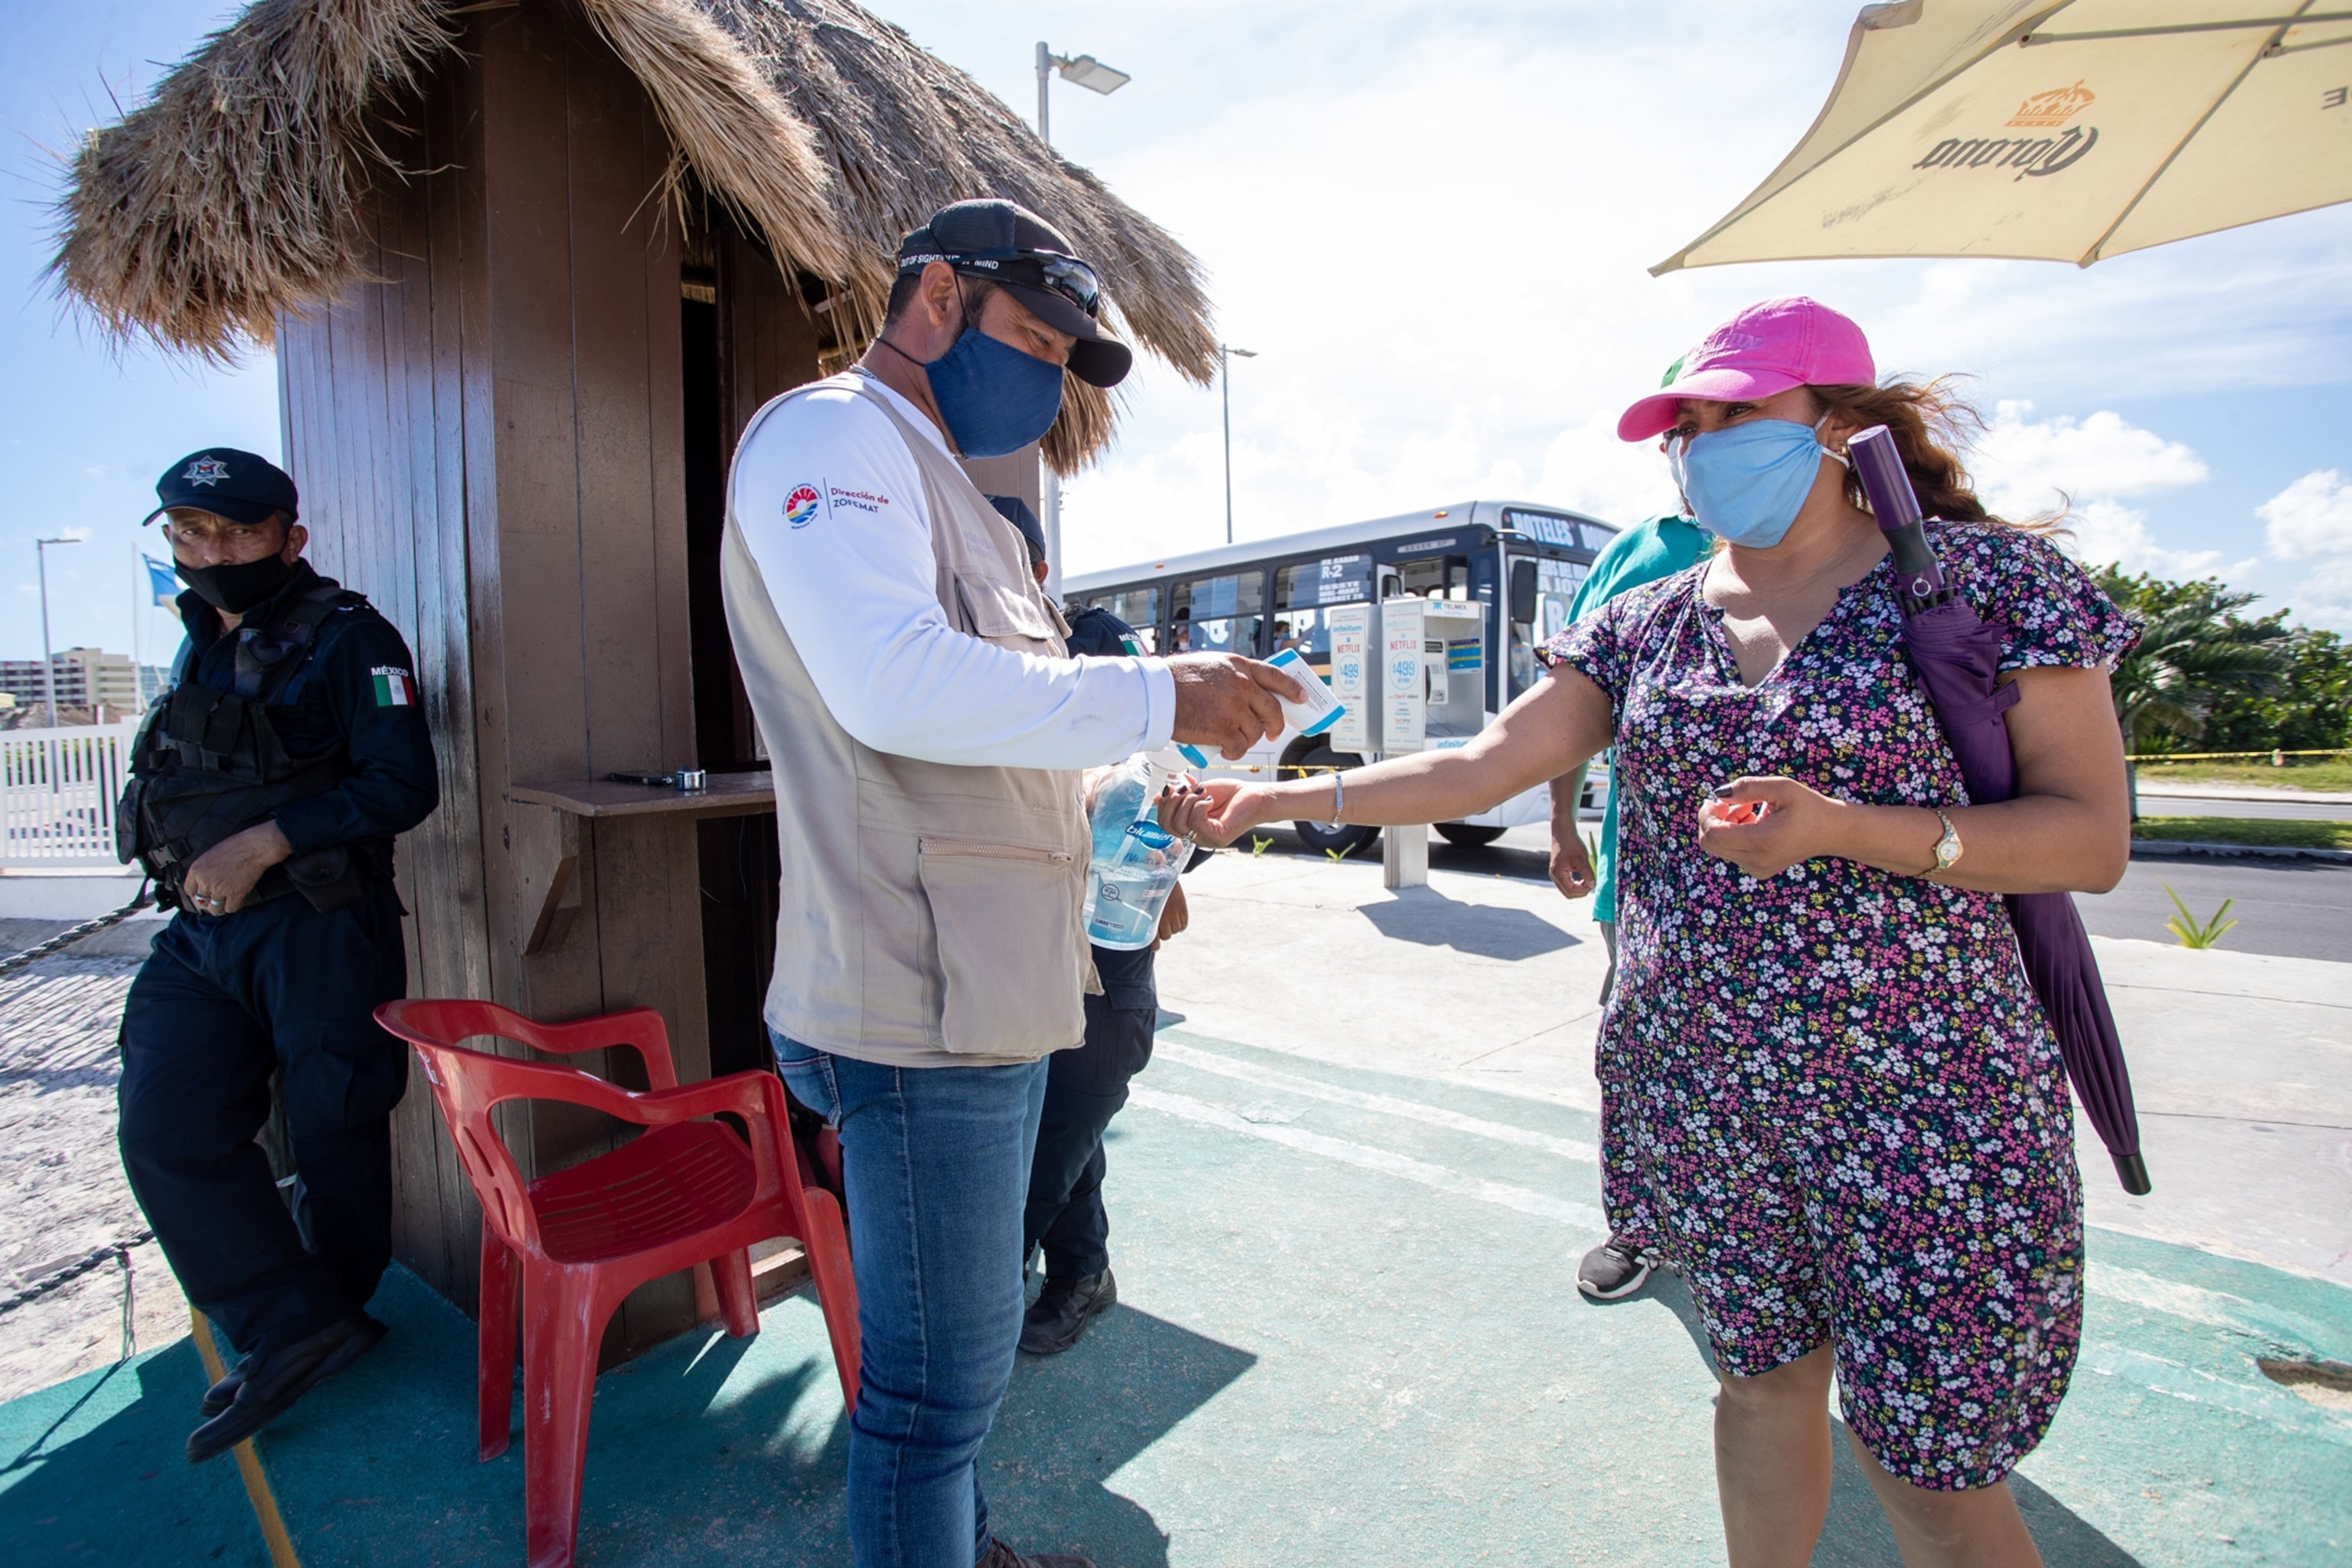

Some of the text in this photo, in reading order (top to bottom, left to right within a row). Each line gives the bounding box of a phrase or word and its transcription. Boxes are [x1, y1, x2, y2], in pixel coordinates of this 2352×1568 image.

[974, 260, 999, 270] MIND
[831, 487, 890, 505] Dirección de
[1510, 511, 1575, 547] HOTELES
[1321, 564, 1343, 579] R-2
[1333, 625, 1363, 633] infinitum
[1337, 644, 1360, 654] NETFLIX
[1390, 640, 1416, 650] NETFLIX
[371, 665, 409, 678] MÉXICO
[1125, 825, 1176, 841] blumen
